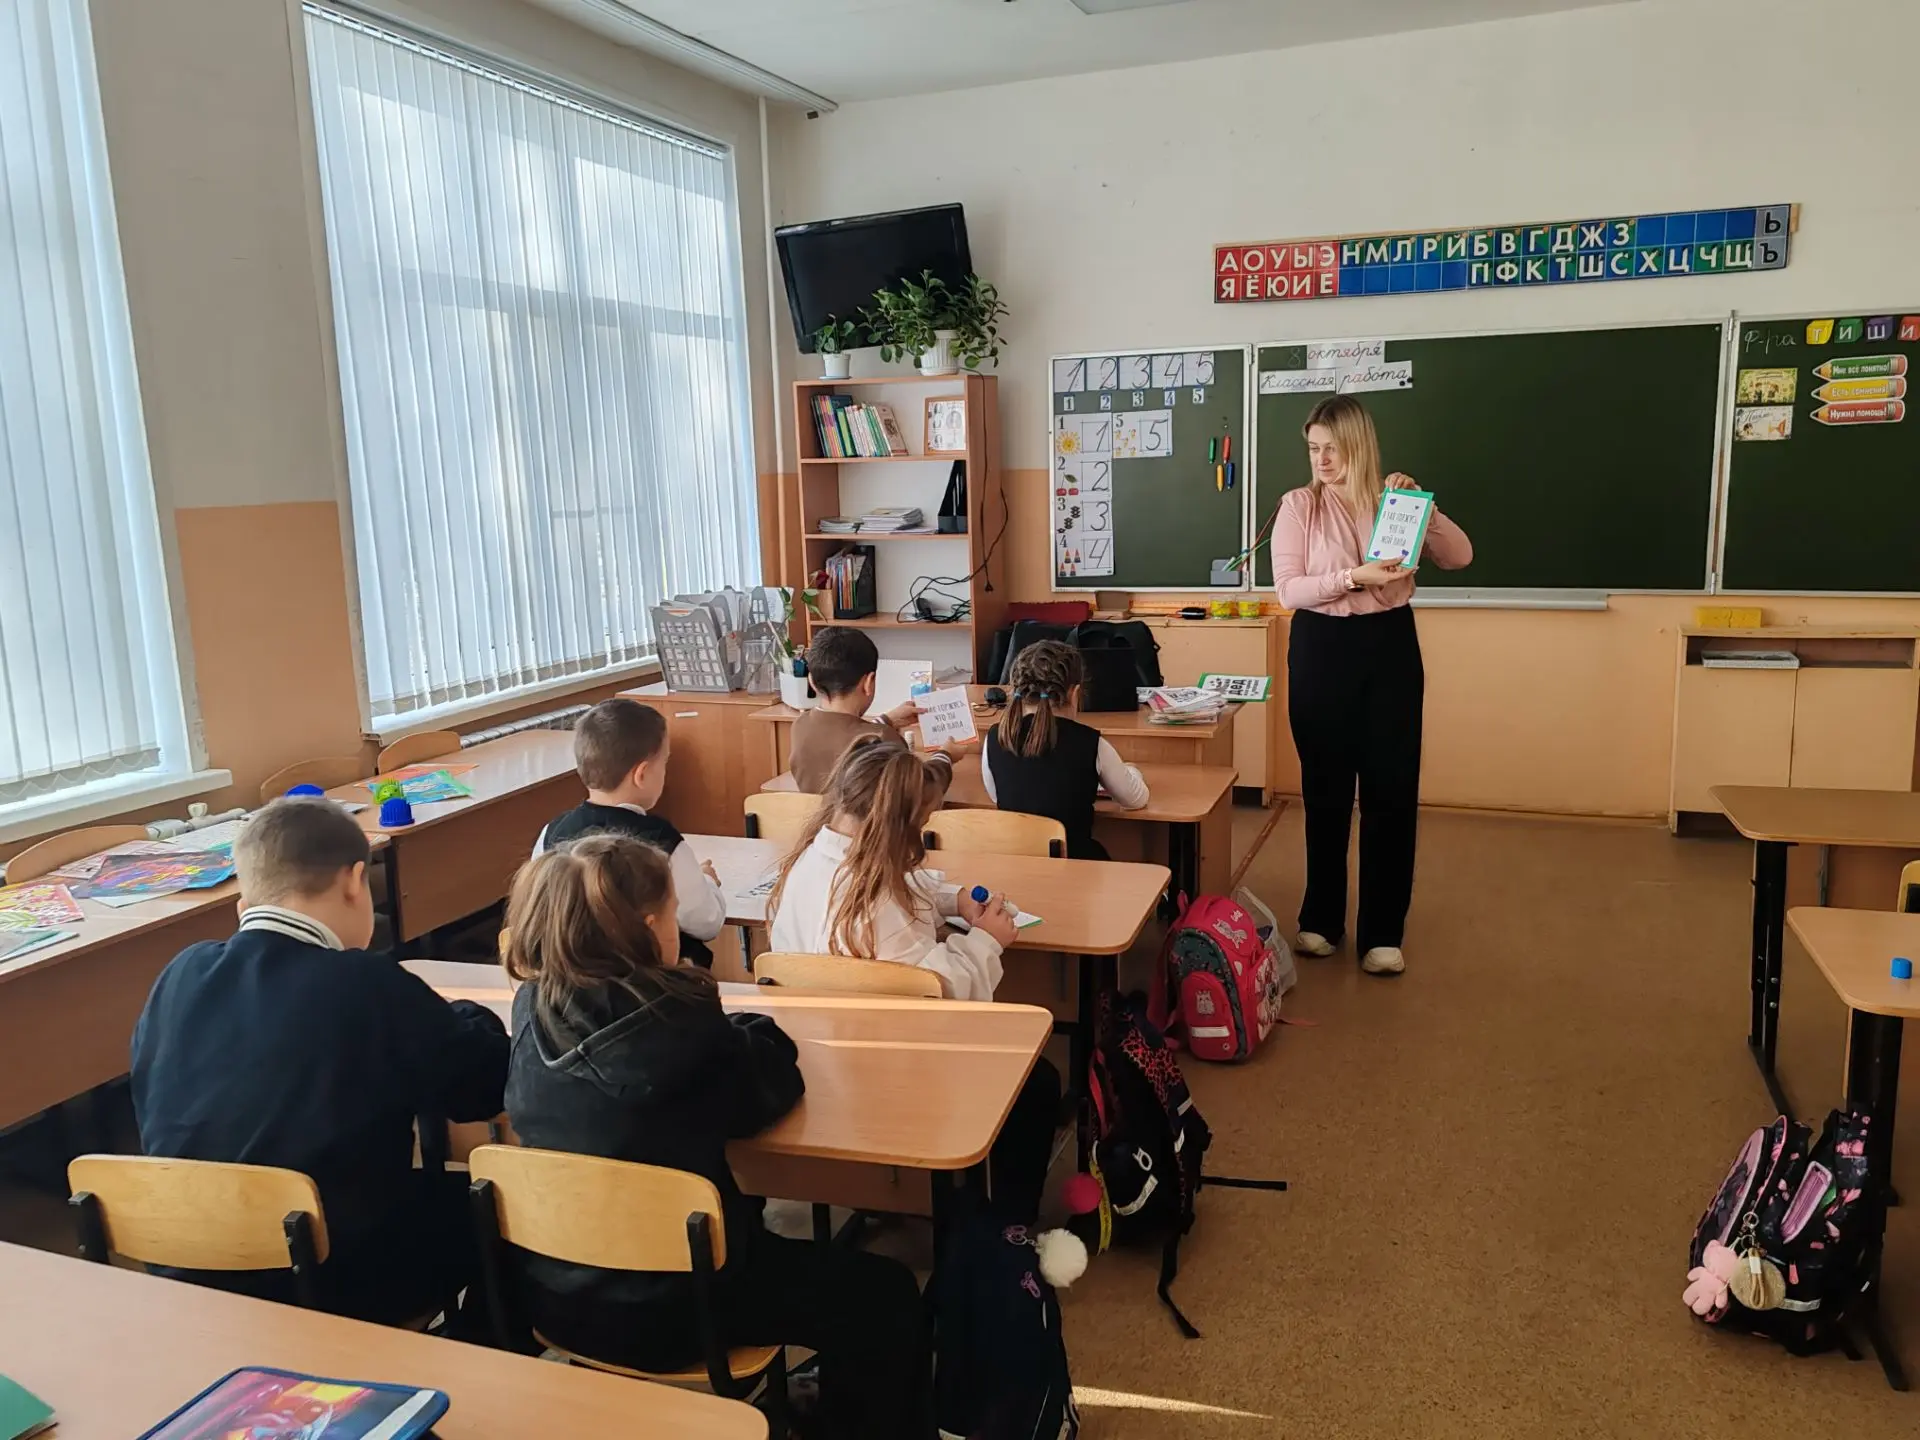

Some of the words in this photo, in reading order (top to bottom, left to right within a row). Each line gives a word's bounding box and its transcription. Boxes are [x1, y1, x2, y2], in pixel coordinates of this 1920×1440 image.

[1067, 359, 1084, 392] 1
[1100, 357, 1117, 389] 2
[1132, 356, 1149, 388] 3
[1164, 354, 1182, 388] 4
[1196, 352, 1214, 385] 5
[1066, 398, 1072, 409] 1
[1102, 396, 1110, 409] 2
[1134, 393, 1143, 406] 3
[1165, 392, 1174, 405] 4
[1194, 389, 1202, 402] 5
[1058, 416, 1065, 429] 1
[1096, 421, 1109, 452] 1
[1115, 414, 1124, 428] 5
[1146, 419, 1168, 451] 5
[1058, 457, 1065, 470] 2
[1092, 461, 1109, 491] 2
[1058, 498, 1065, 511] 3
[1091, 501, 1108, 531] 3
[1059, 535, 1067, 548] 4
[1089, 538, 1110, 568] 4
